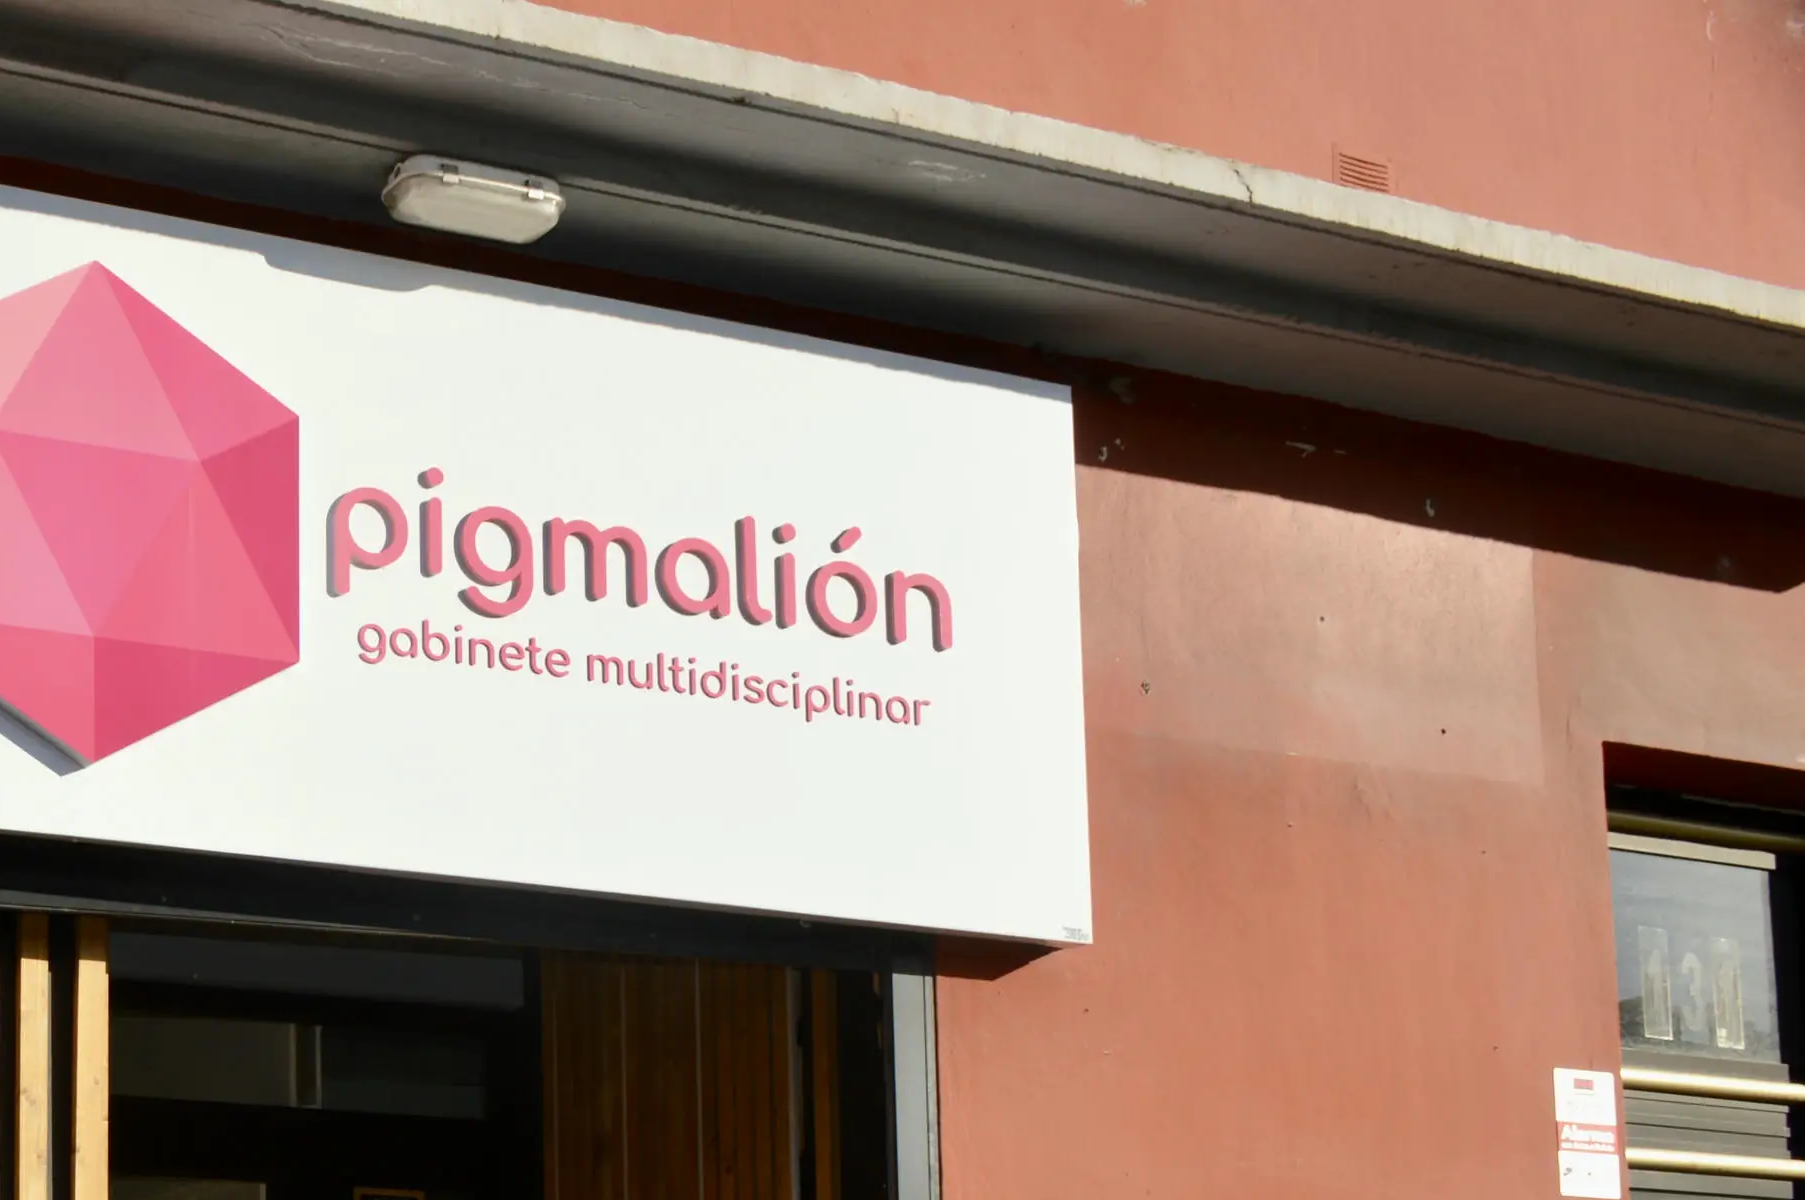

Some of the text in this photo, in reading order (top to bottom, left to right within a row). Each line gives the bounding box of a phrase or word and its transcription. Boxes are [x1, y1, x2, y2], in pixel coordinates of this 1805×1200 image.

[326, 467, 952, 651] pigmalión
[357, 620, 931, 725] gabinete multidisciplinar
